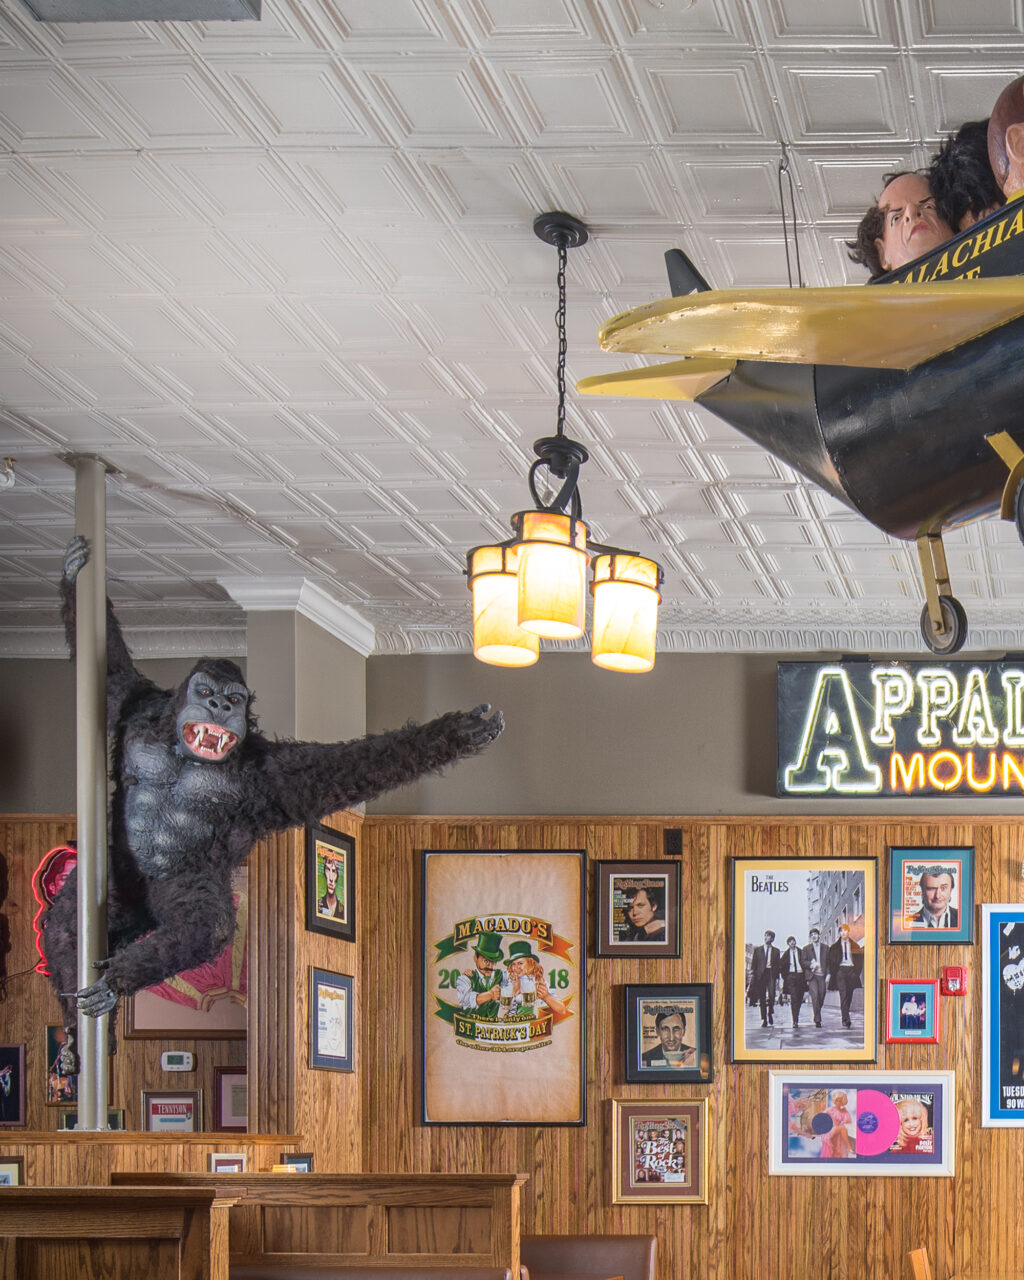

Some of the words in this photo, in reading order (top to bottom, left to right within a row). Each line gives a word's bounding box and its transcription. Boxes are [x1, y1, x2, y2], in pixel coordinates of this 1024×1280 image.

[752, 876, 789, 895] BEATLES
[458, 917, 549, 939] MACADO'S
[438, 969, 461, 989] 20
[548, 969, 569, 989] 18
[459, 1022, 473, 1036] ST.
[475, 1025, 527, 1041] PATRICK'S
[529, 1022, 548, 1038] DAY
[157, 1105, 187, 1114] TENNYSON
[1006, 1099, 1016, 1109] 90
[641, 1141, 676, 1154] Best
[640, 1154, 679, 1172] Rock
